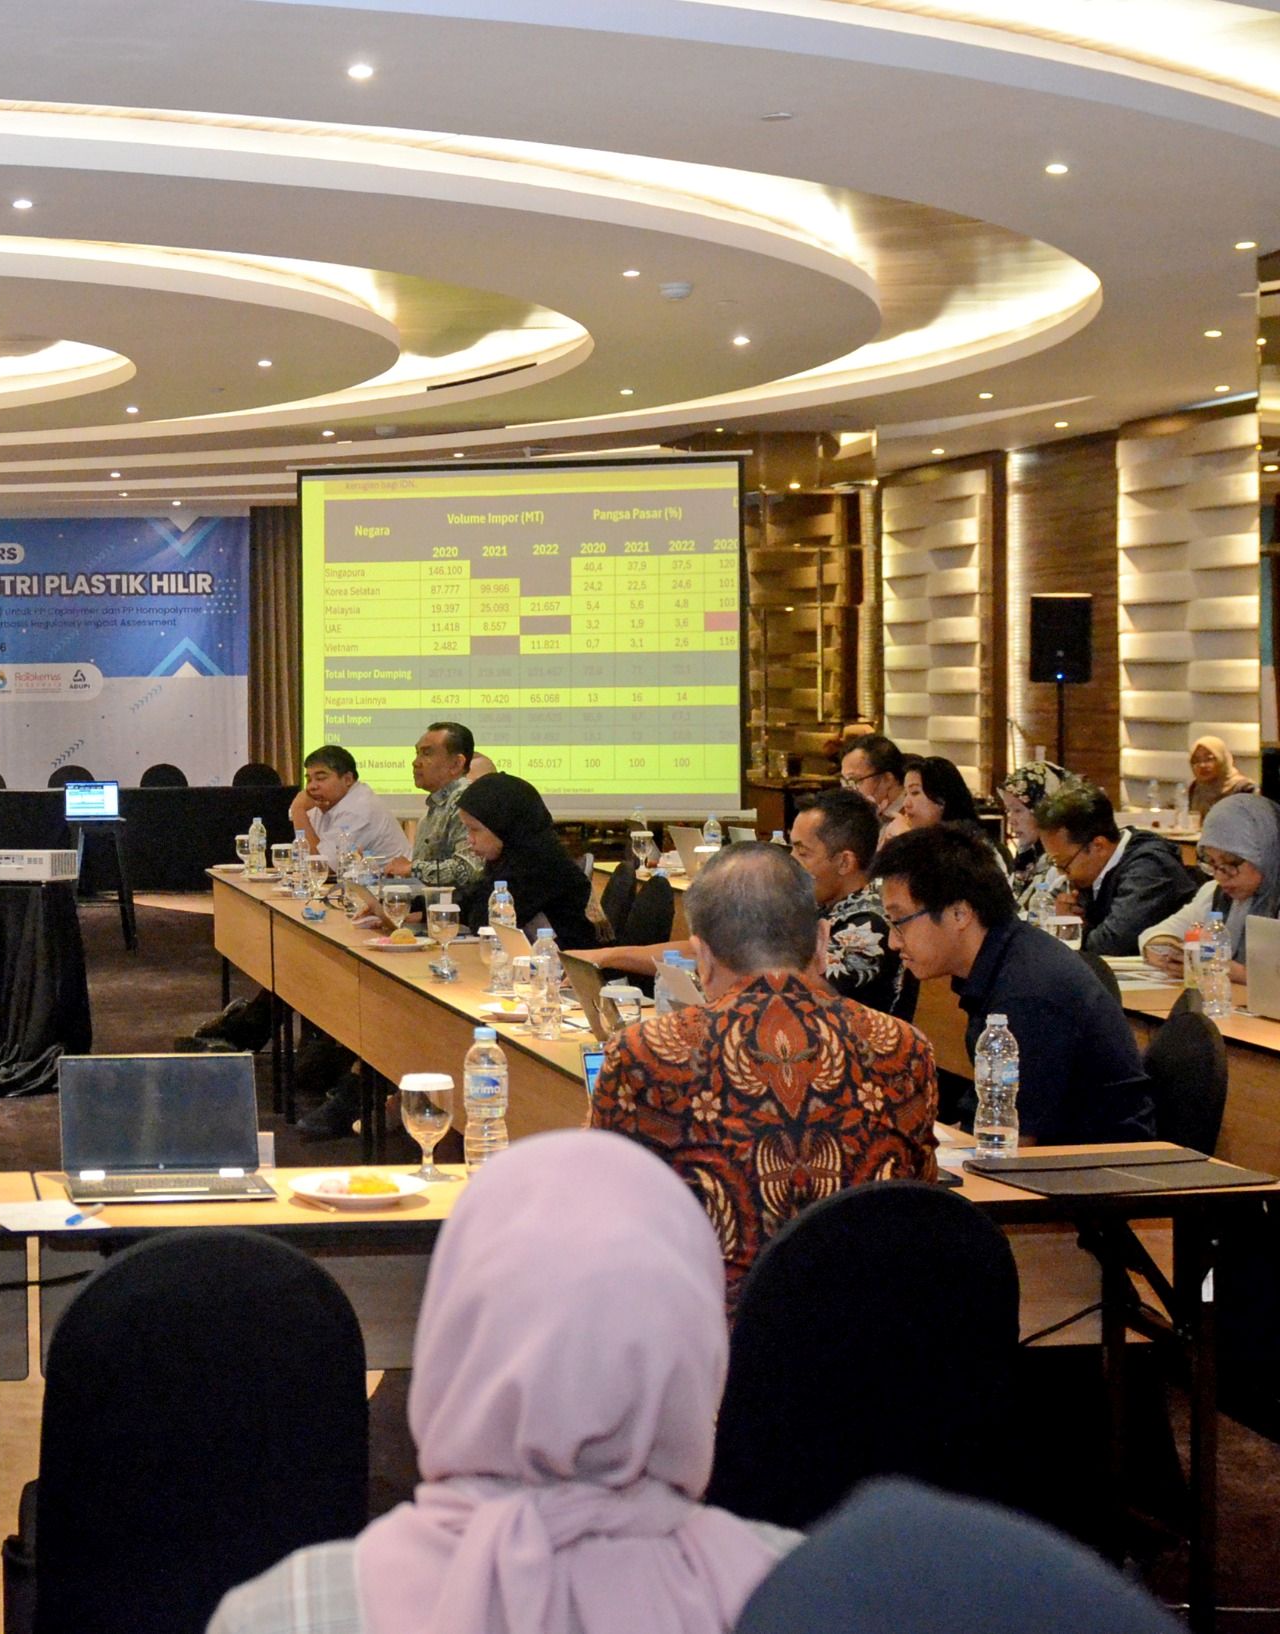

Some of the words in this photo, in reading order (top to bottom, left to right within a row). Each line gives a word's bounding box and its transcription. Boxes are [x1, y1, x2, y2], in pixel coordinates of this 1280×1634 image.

[447, 513, 486, 524] Volume
[488, 513, 518, 526] Impor
[520, 511, 545, 524] (MT)
[593, 509, 630, 521] Pangsa
[633, 508, 662, 519] Pasar
[664, 507, 683, 520] (%)
[355, 526, 390, 538] Negara
[432, 547, 458, 558] 2020
[482, 546, 508, 557] 2021
[533, 544, 559, 555] 2022
[580, 543, 606, 553] 2020
[625, 542, 649, 552] 2021
[669, 540, 695, 551] 2022
[325, 568, 365, 578] Singapura
[428, 567, 462, 576] 146.100
[584, 562, 603, 572] 40,4
[627, 561, 646, 572] 37,9
[672, 560, 692, 571] 37,5
[45, 573, 145, 596] PLASTIK
[151, 572, 212, 595] HILIR
[325, 587, 347, 596] Korea
[350, 586, 380, 596] Selatan
[431, 585, 460, 594] 87.777
[480, 584, 509, 593] 99.966
[584, 581, 603, 591] 24,2
[627, 580, 646, 591] 22,5
[672, 579, 692, 590] 24,6
[136, 606, 201, 615] Homopolymer
[326, 606, 360, 616] Malaysia
[432, 604, 460, 613] 19.397
[480, 603, 509, 613] 25.093
[530, 602, 560, 612] 21.657
[586, 600, 600, 611] 5,4
[674, 599, 689, 609] 4,8
[326, 624, 342, 633] UAE
[432, 623, 460, 632] 11.418
[483, 621, 506, 631] 8.557
[586, 619, 600, 630] 3,2
[630, 619, 644, 629] 1,9
[674, 617, 688, 628] 3,6
[325, 643, 358, 652] Vietnam
[433, 641, 457, 651] 2.482
[531, 640, 560, 649] 11.821
[586, 638, 600, 649] 0,7
[630, 638, 644, 648] 3,1
[674, 637, 689, 647] 2,6
[325, 670, 347, 679] Total
[349, 670, 371, 680] Impor
[374, 670, 413, 681] Dumping
[326, 697, 353, 706] Negara
[356, 696, 386, 706] Lainnya
[430, 694, 460, 704] 45.473
[481, 694, 509, 703] 70.420
[530, 694, 560, 703] 65.068
[632, 692, 643, 702] 16
[677, 691, 688, 701] 14
[325, 715, 347, 724] Total
[349, 716, 372, 726] Impor
[326, 733, 341, 742] IDN
[368, 759, 405, 768] Nasional
[528, 758, 562, 768] 455.017
[584, 759, 600, 768] 100
[629, 758, 645, 768] 100
[673, 757, 689, 767] 100
